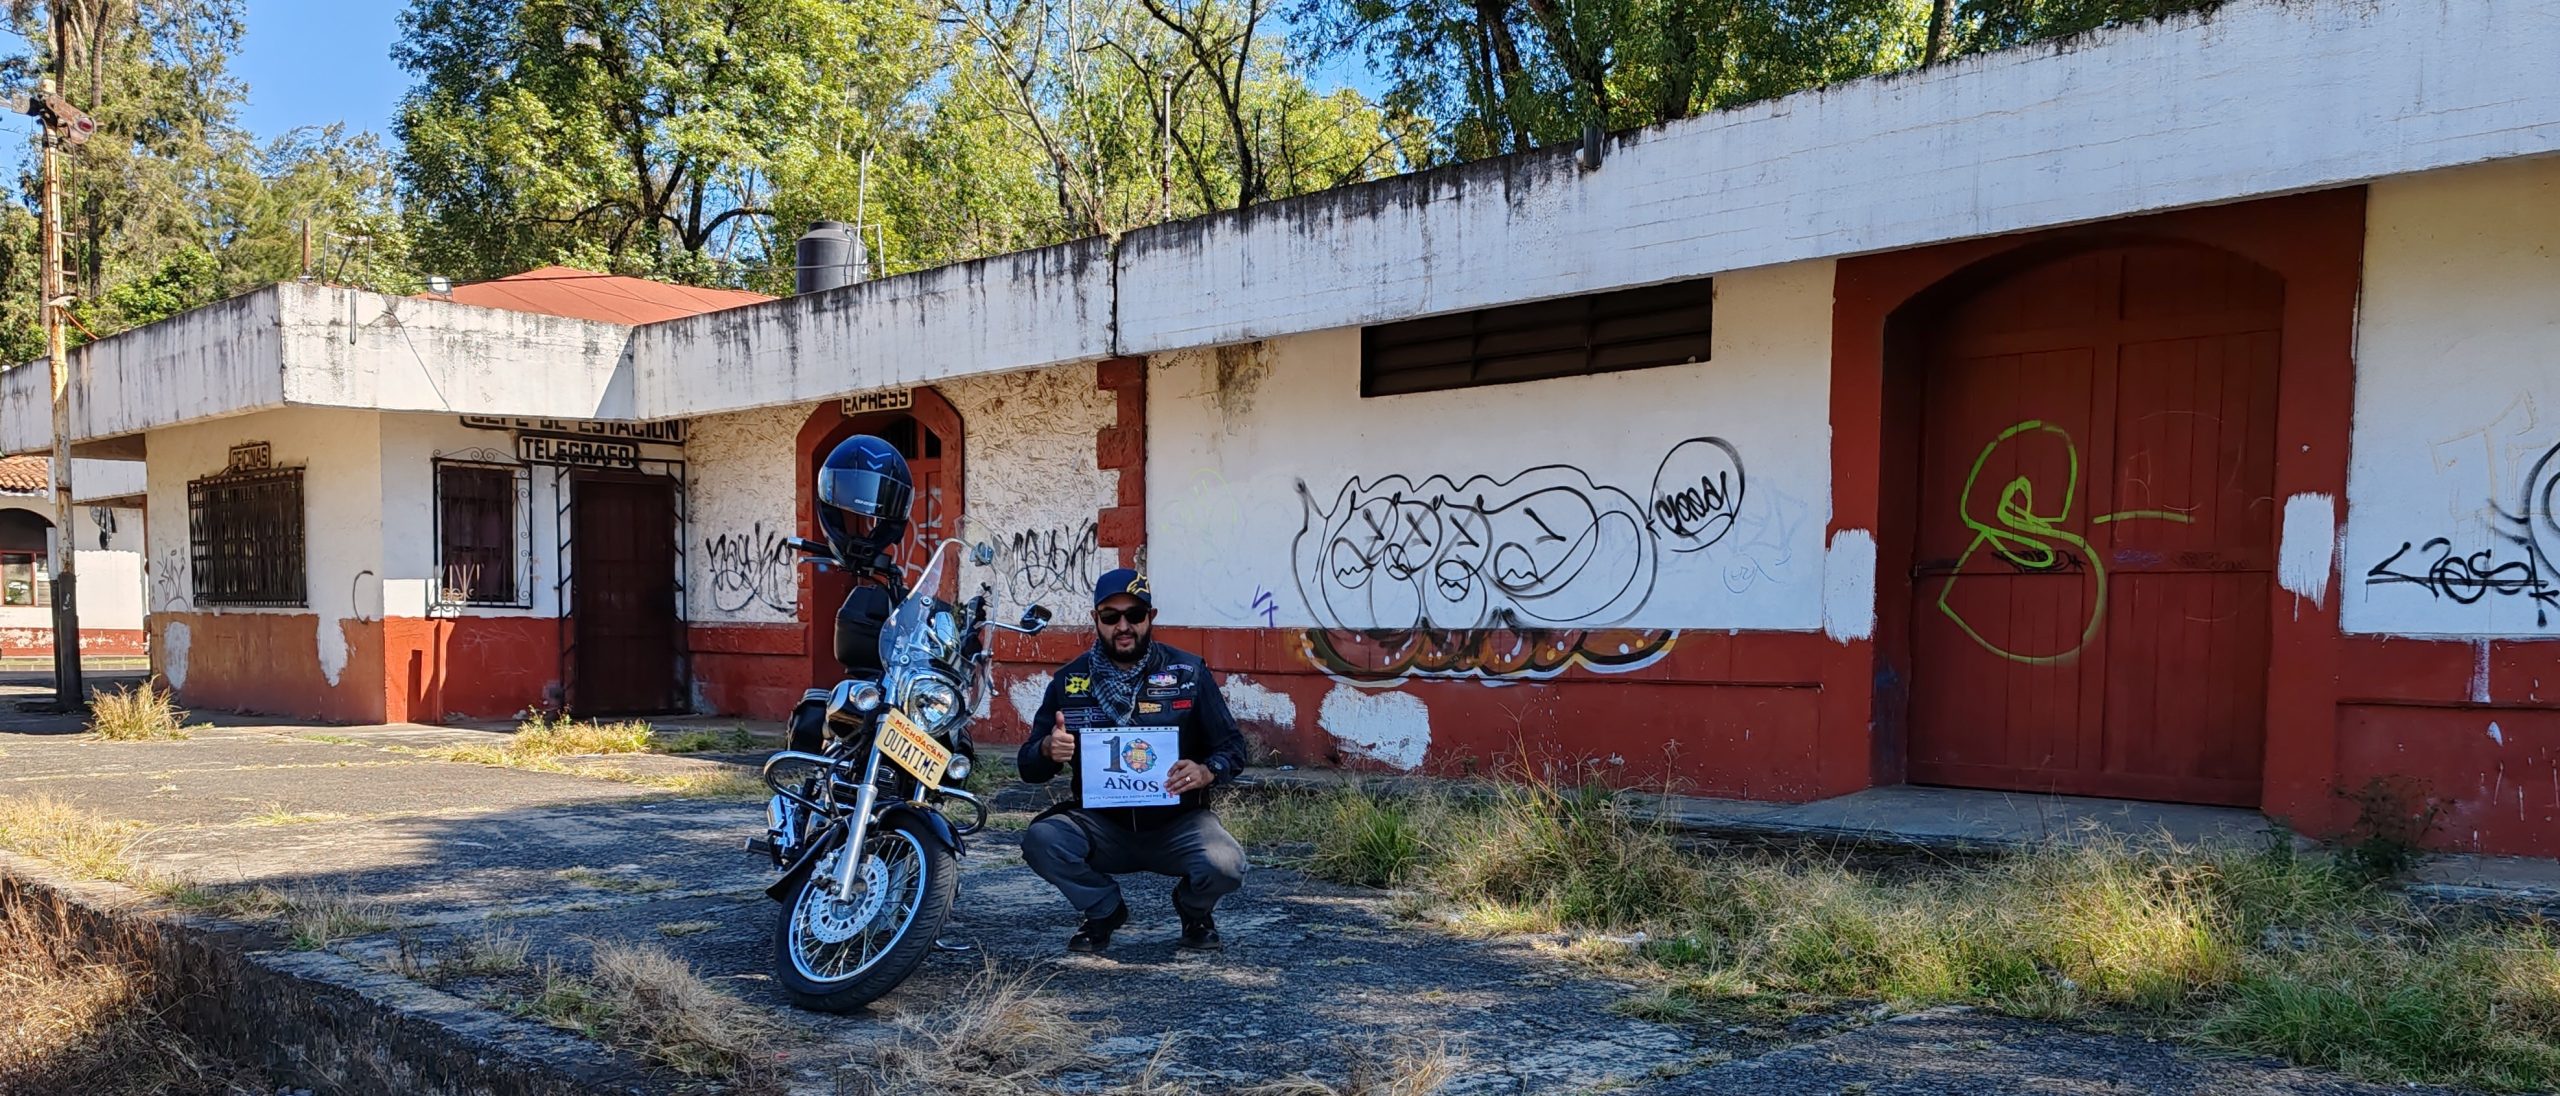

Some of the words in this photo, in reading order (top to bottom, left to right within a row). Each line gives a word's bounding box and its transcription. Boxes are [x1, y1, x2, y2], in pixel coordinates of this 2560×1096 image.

[523, 438, 629, 466] TELEGRAFO
[883, 728, 939, 781] OUTATIME
[1103, 774, 1159, 793] AÑOS
